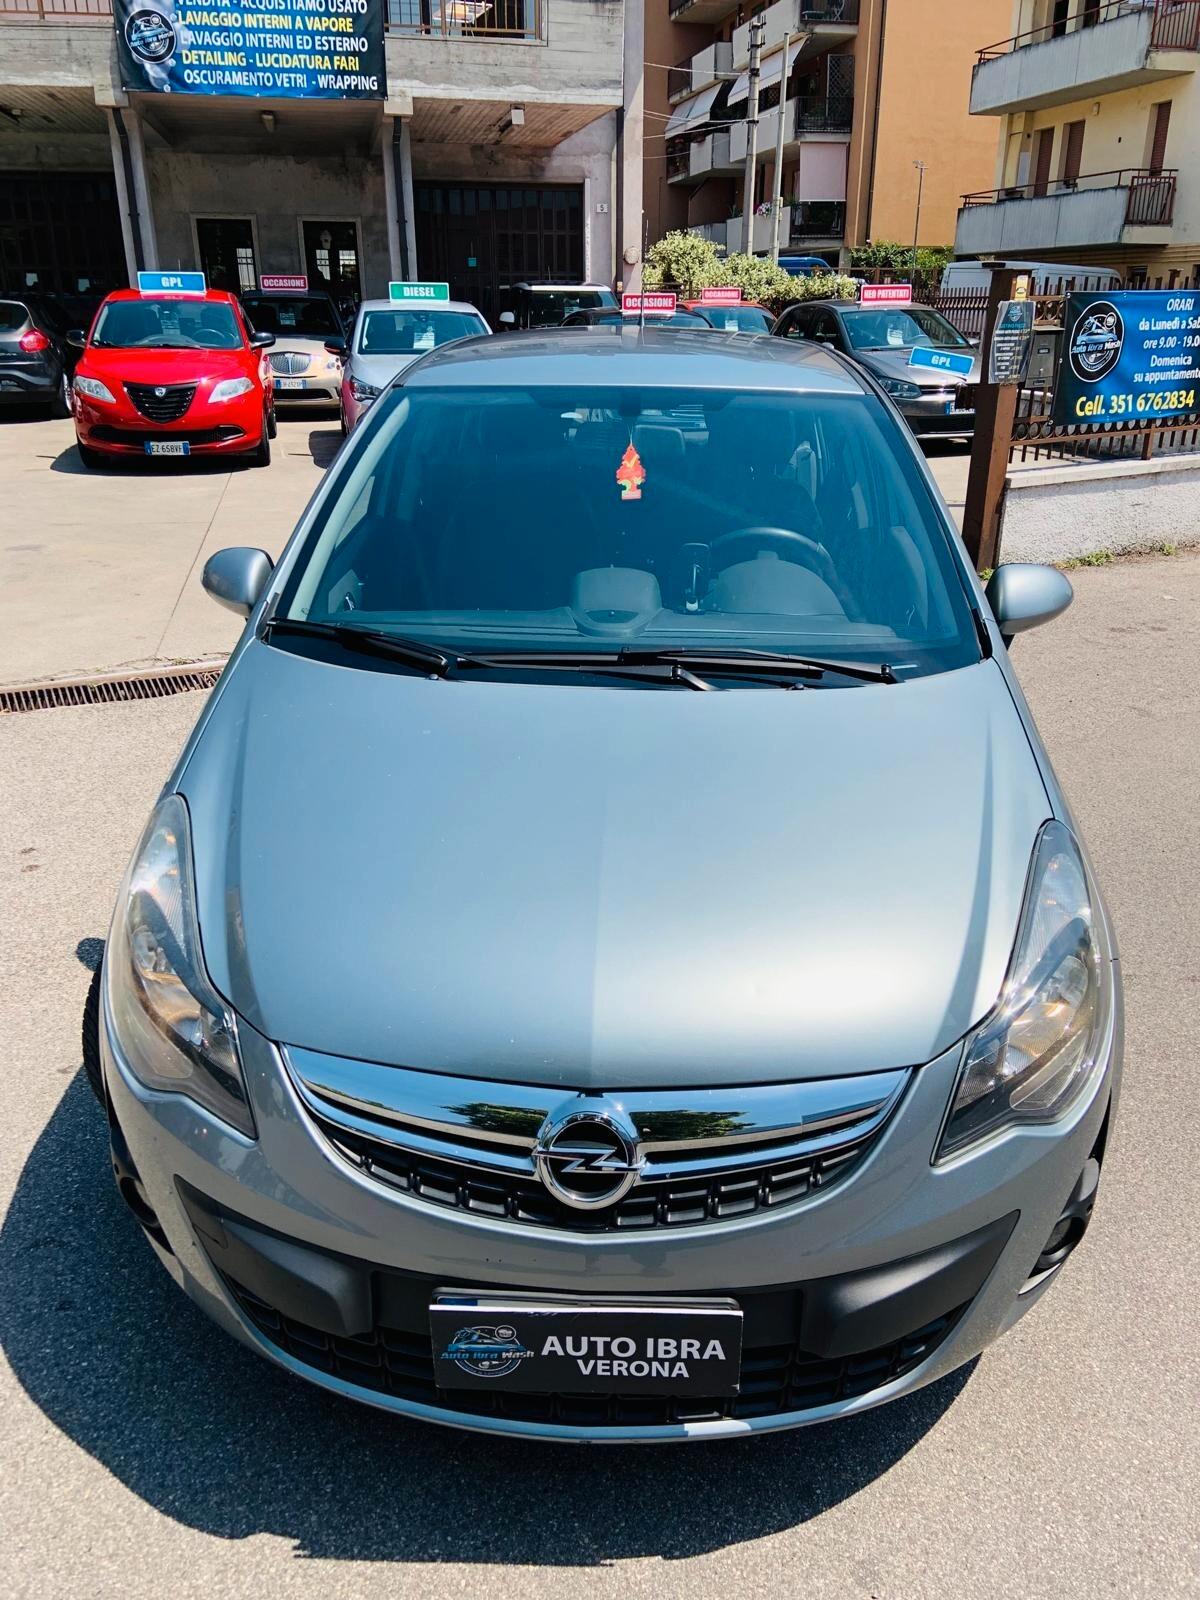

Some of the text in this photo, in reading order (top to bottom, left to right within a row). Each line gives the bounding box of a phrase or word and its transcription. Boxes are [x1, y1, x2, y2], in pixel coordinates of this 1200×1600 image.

[329, 0, 368, 14] USATO
[178, 10, 353, 32] LAVAGGIO INTERNI A VAPORE
[180, 30, 243, 47] LAVAGGIO
[246, 33, 293, 49] INTERNI
[296, 35, 312, 50] ED
[315, 36, 368, 52] ESTERNO
[182, 49, 246, 66] DETAILING
[255, 52, 331, 70] LUCIDATURA
[333, 56, 359, 71] FARI
[184, 69, 273, 86] OSCURAMENTO
[275, 72, 307, 88] VETRI
[317, 74, 378, 90] WRAPPING
[161, 276, 183, 288] GPL
[263, 278, 304, 287] OCCASIONE
[403, 286, 435, 297] DIESEL
[625, 297, 673, 308] OCCASIONE
[1166, 298, 1194, 312] ORARI
[1139, 318, 1150, 331] da
[1180, 319, 1187, 330] a
[1143, 339, 1158, 350] ore
[1158, 336, 1177, 349] 9.00
[1182, 334, 1200, 348] 19.0
[930, 354, 952, 368] GPL
[1150, 352, 1193, 367] Domenica
[1133, 372, 1144, 383] su
[1075, 390, 1195, 417] Cell. 351 6762834
[501, 1350, 535, 1360] Wash
[541, 1336, 727, 1360] AUTO IBRA
[576, 1359, 690, 1378] VERONA
